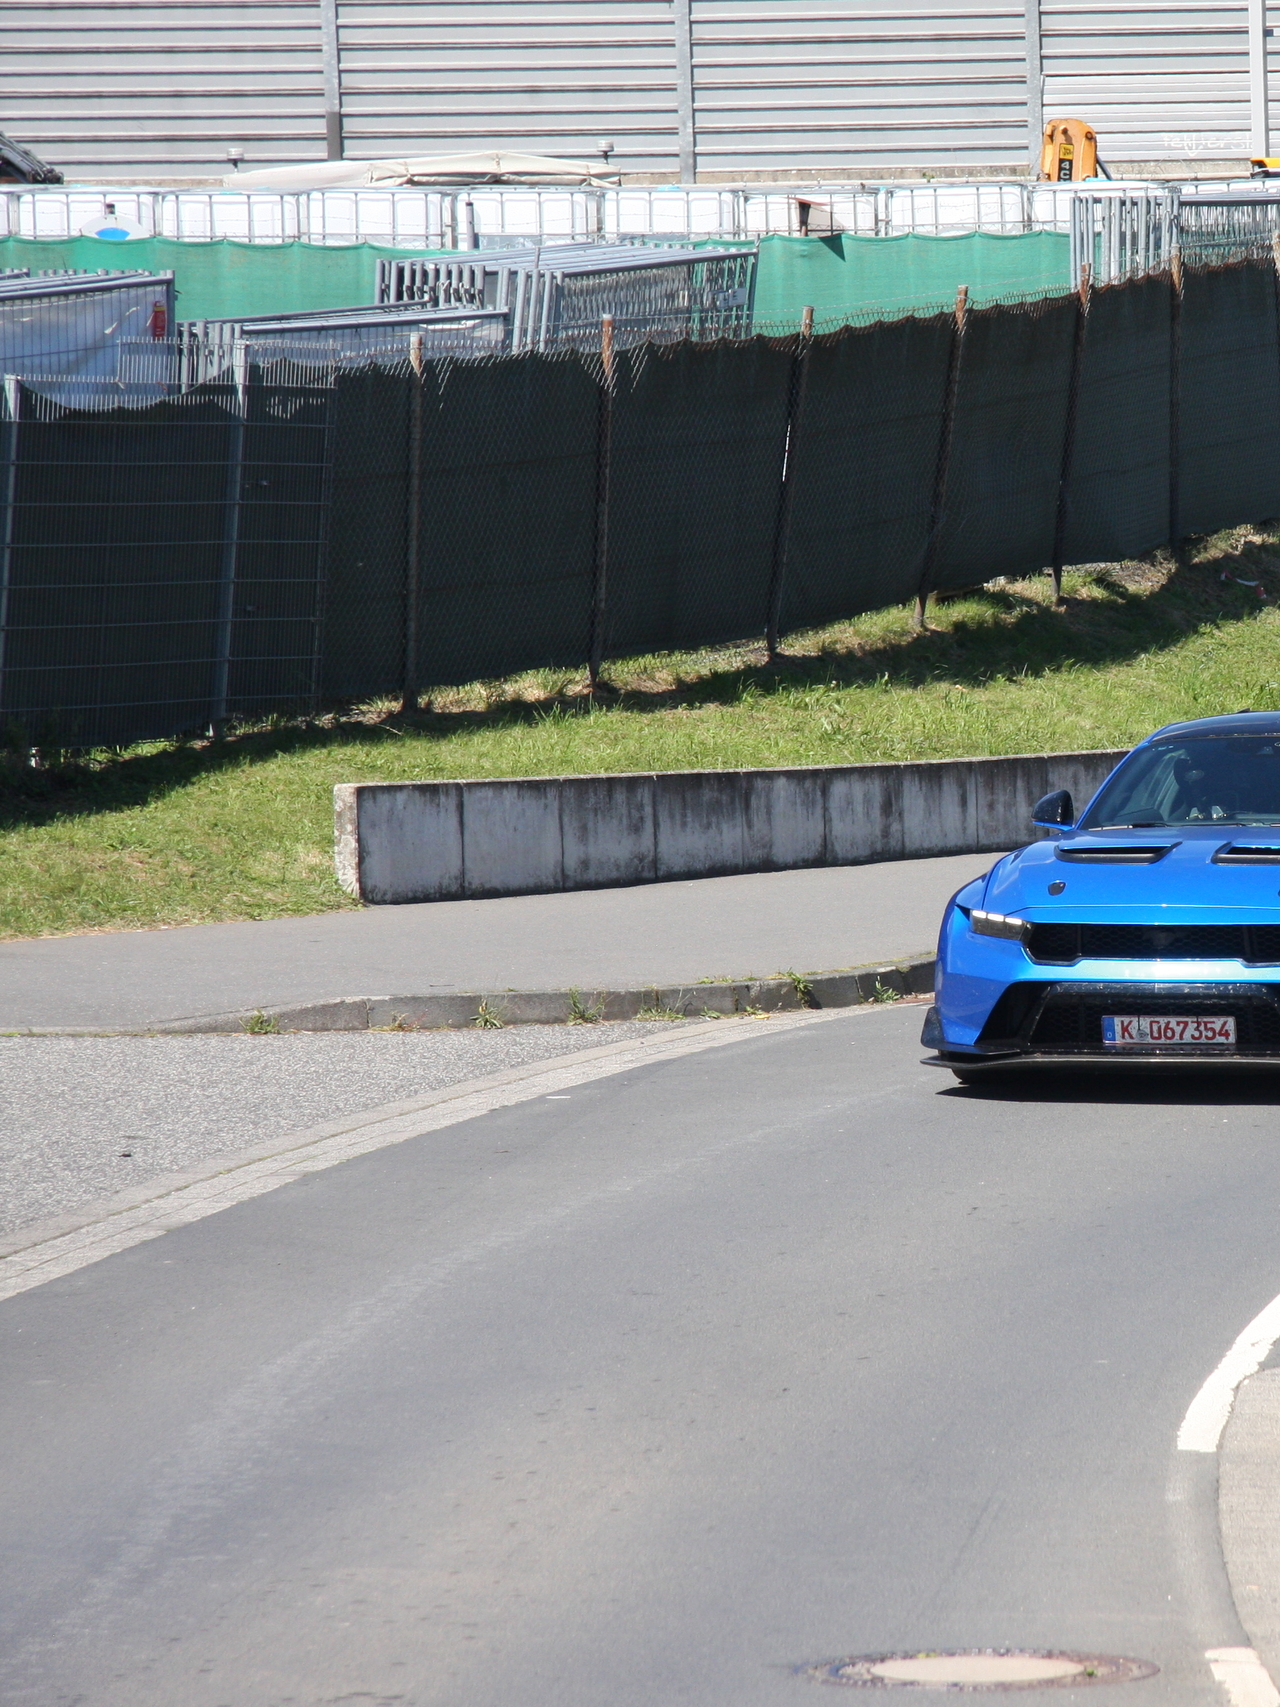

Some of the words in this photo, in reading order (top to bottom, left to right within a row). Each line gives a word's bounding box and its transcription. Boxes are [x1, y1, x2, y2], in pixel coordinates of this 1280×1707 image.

[1060, 161, 1071, 182] 4C
[1120, 1019, 1135, 1040] K
[1149, 1019, 1231, 1041] 067354
